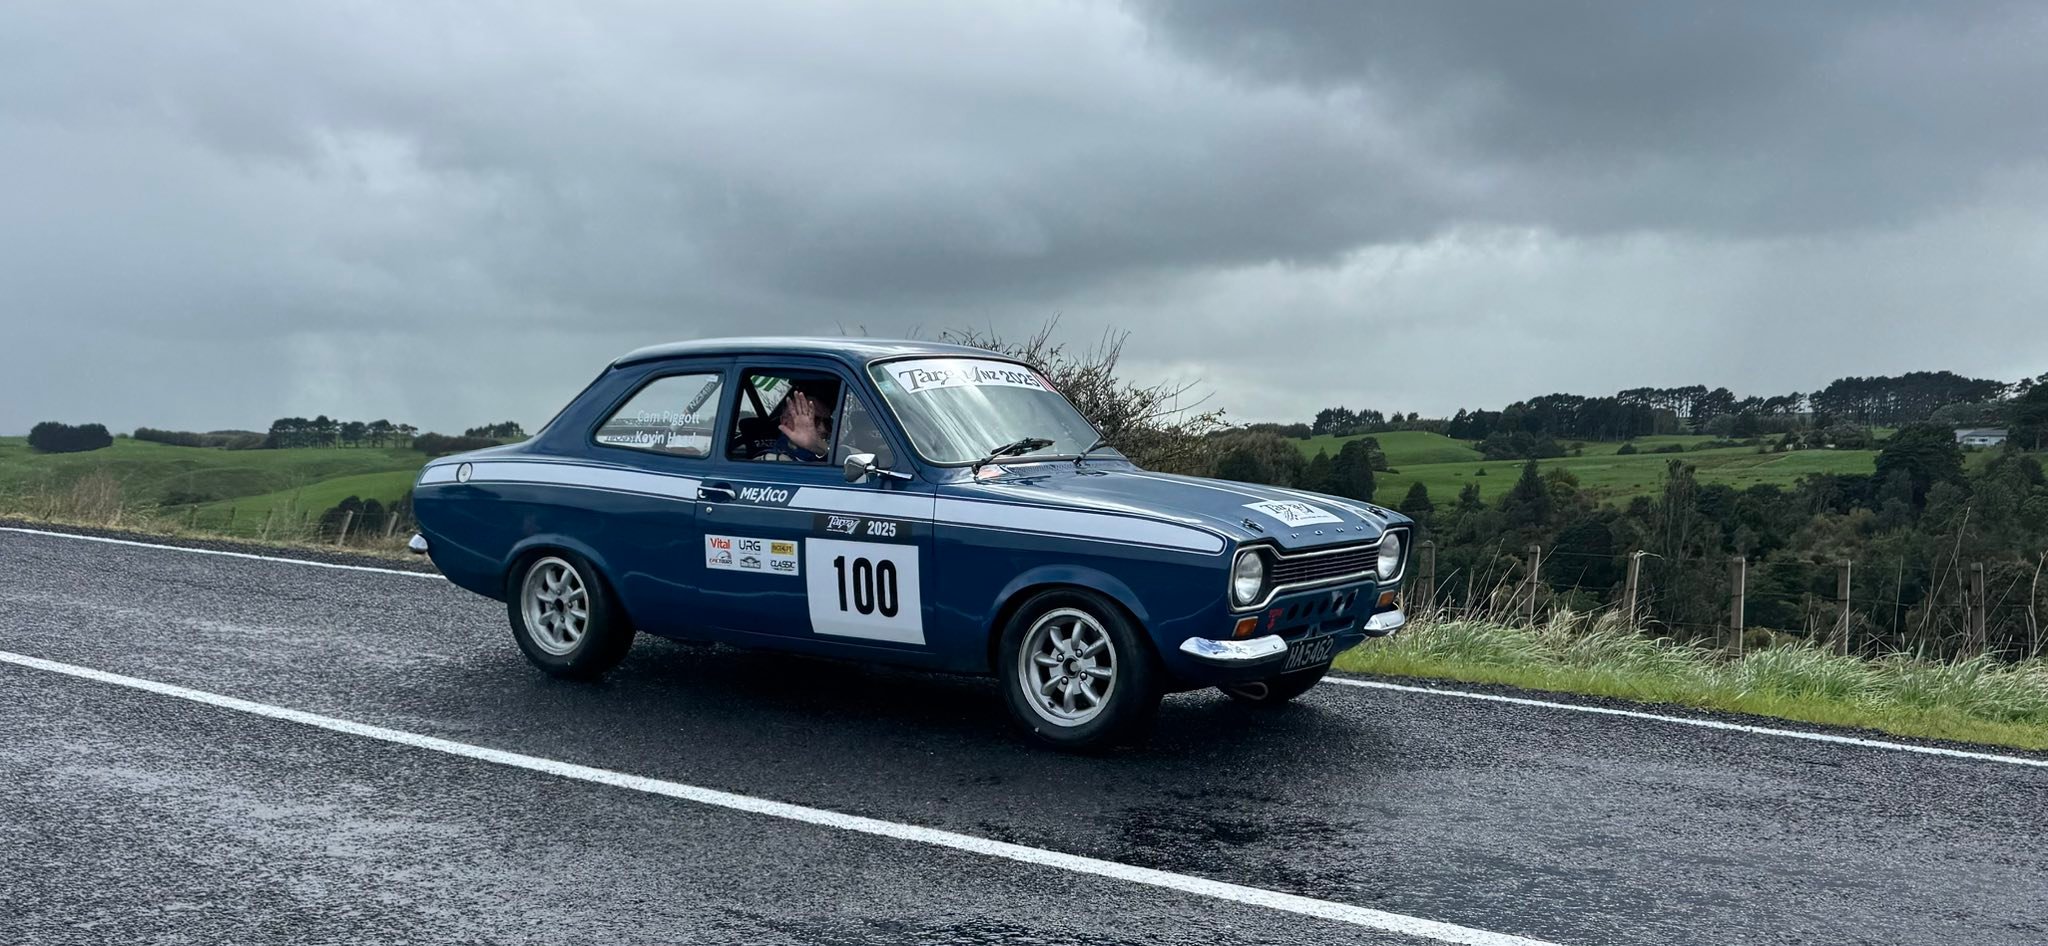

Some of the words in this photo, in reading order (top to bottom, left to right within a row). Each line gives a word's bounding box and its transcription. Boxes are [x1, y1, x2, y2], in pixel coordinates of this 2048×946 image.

[980, 369, 1000, 380] NZ
[1000, 370, 1041, 387] 2025
[638, 410, 660, 423] Cam
[663, 410, 700, 426] Piggott
[635, 430, 665, 444] Kevin
[739, 486, 789, 503] MEXICO
[867, 520, 897, 538] 2025
[710, 537, 731, 549] Vital
[739, 539, 761, 552] URG
[833, 555, 899, 618] 100
[1285, 637, 1335, 669] HA5462
